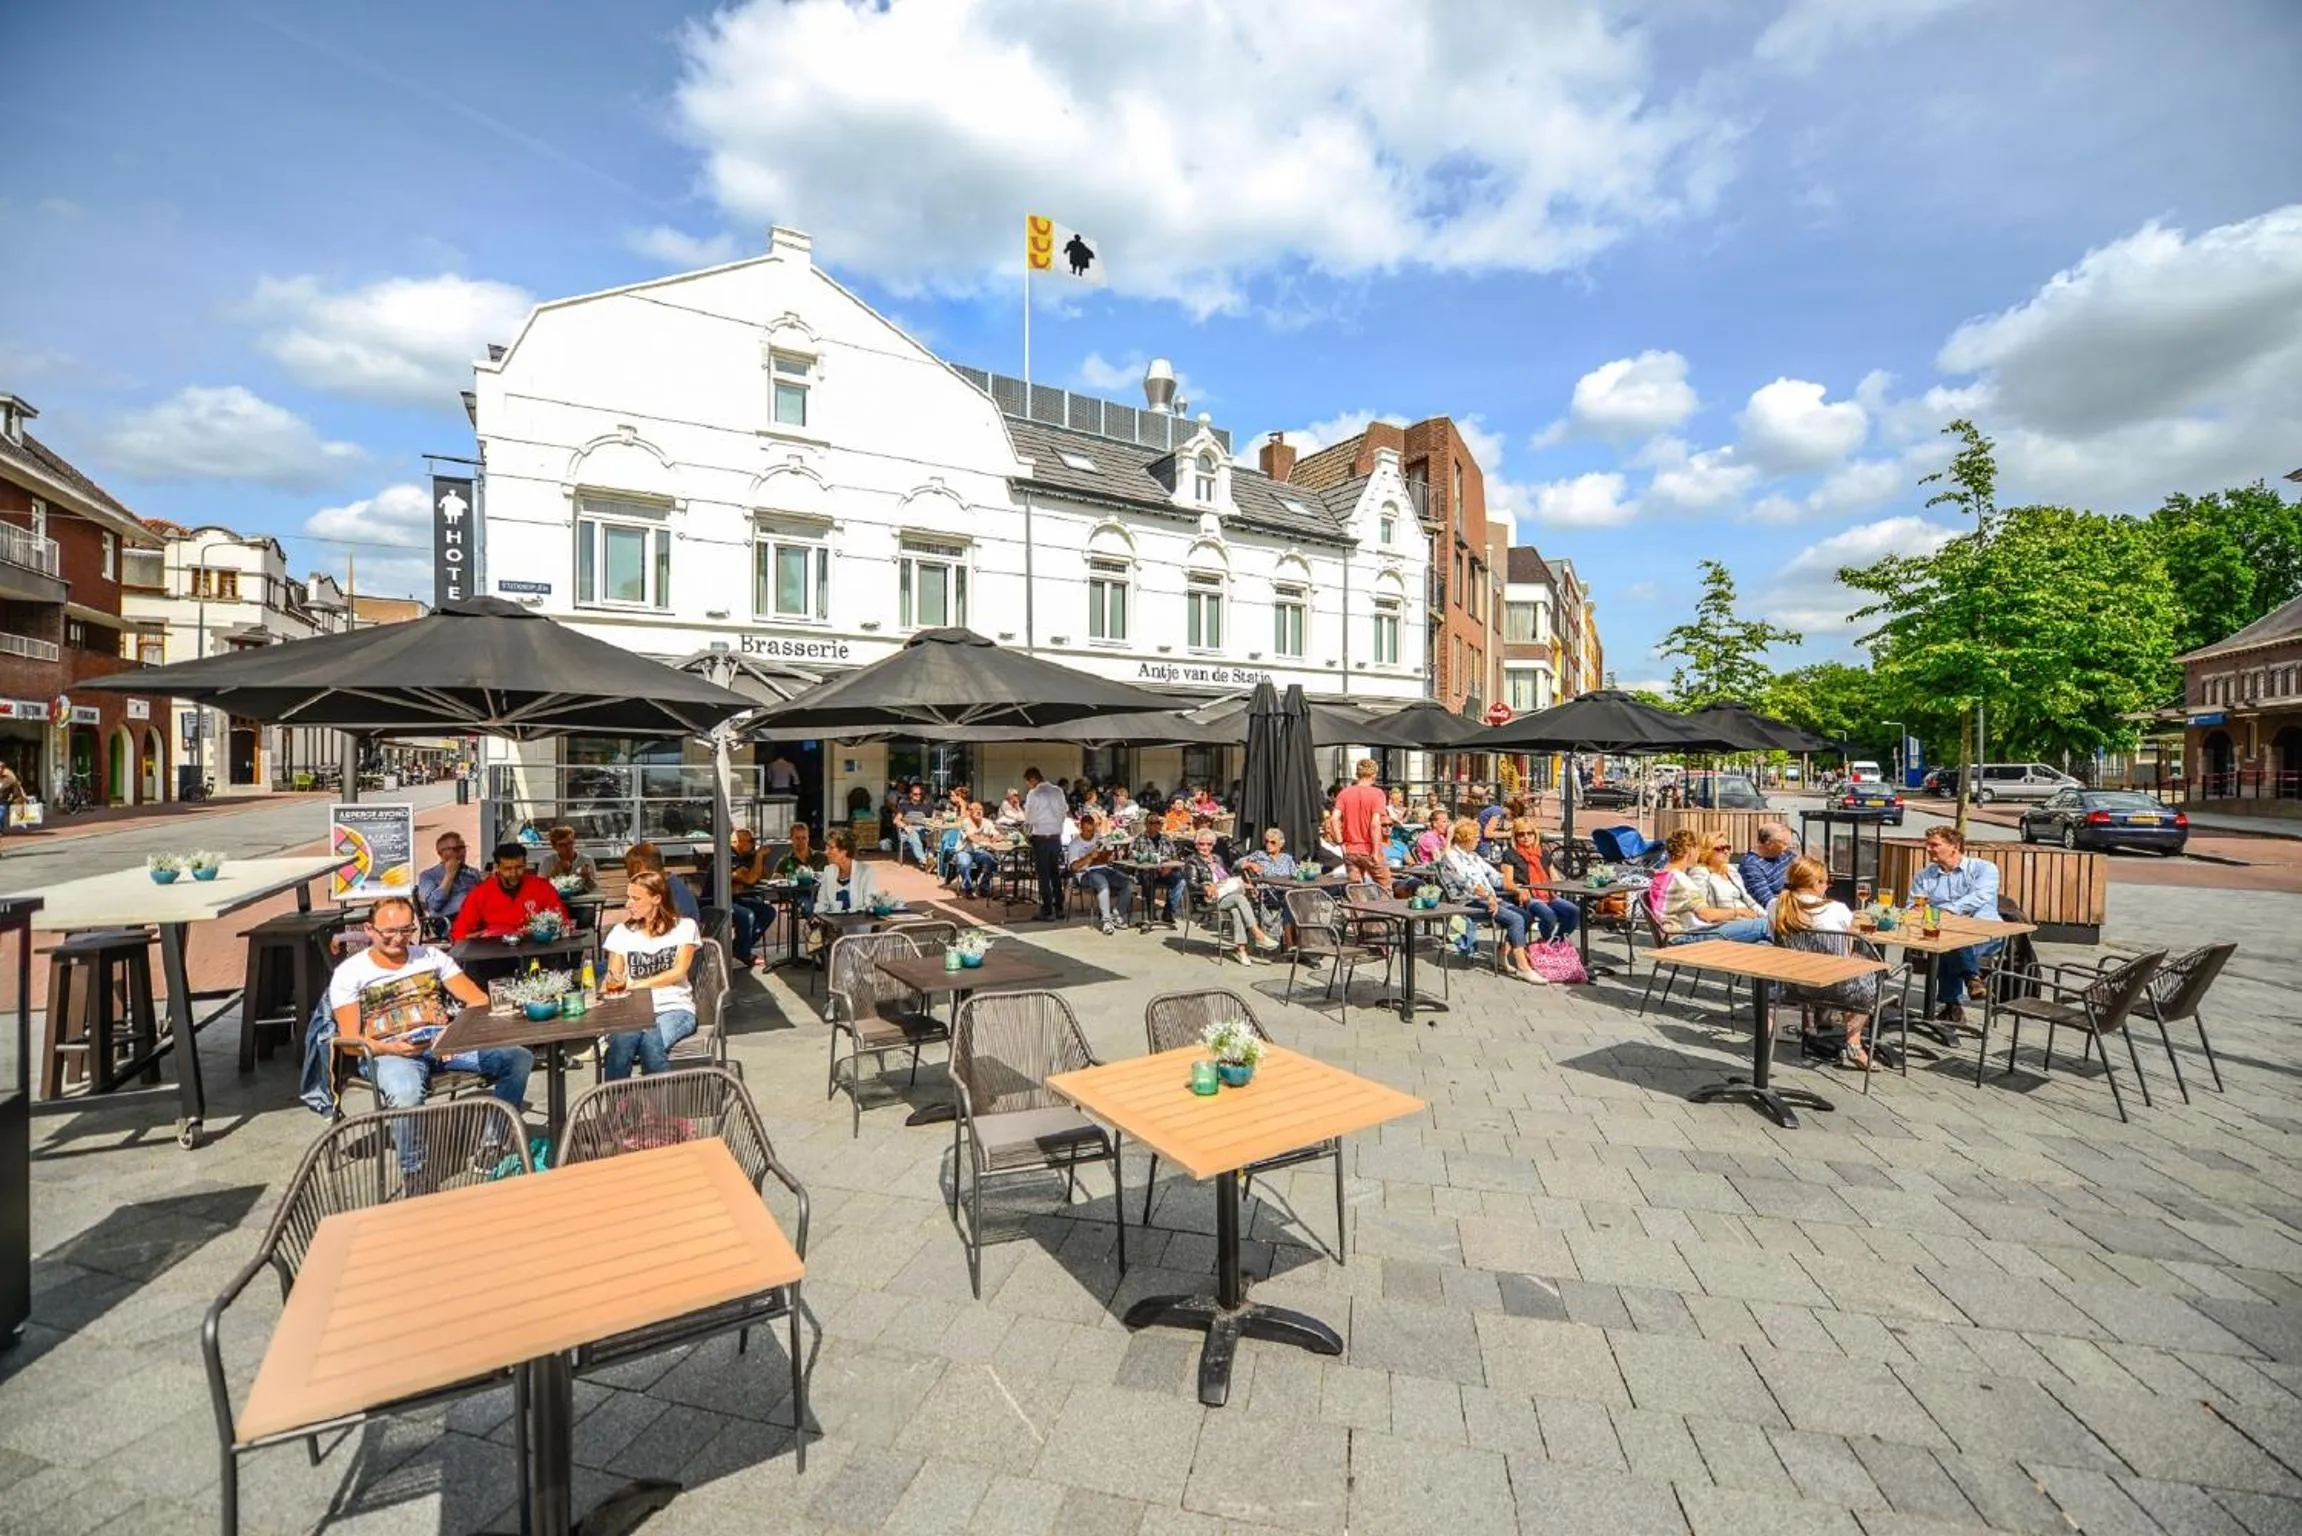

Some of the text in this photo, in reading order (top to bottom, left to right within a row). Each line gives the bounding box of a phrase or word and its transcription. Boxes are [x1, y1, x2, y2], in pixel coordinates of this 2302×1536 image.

[445, 529, 464, 601] HOTE
[741, 634, 850, 659] Brasserie
[1138, 662, 1180, 682] Antje
[1183, 667, 1209, 681] van
[1211, 668, 1229, 682] de
[631, 963, 672, 976] EDITIO
